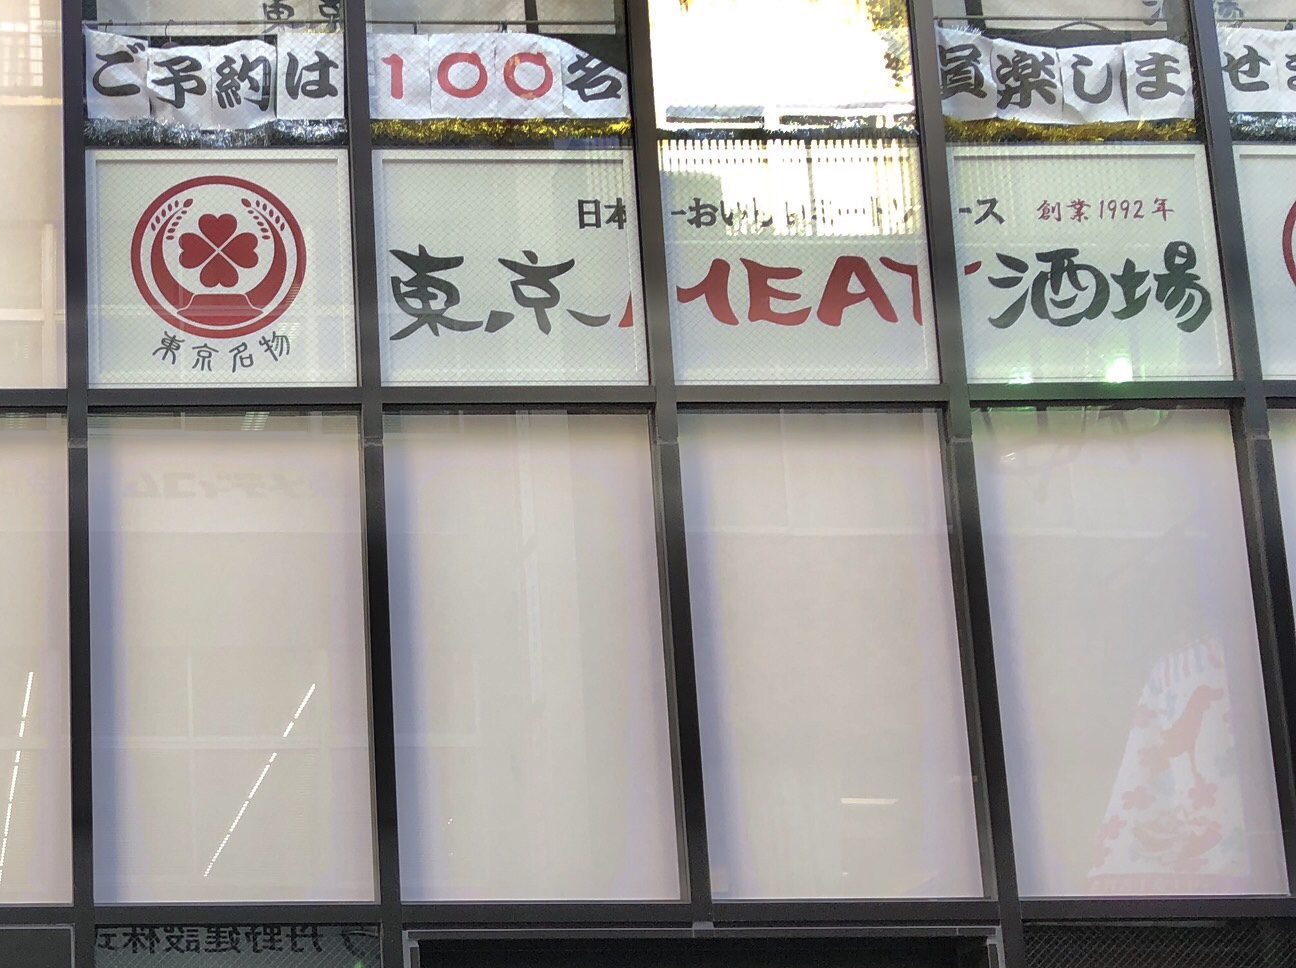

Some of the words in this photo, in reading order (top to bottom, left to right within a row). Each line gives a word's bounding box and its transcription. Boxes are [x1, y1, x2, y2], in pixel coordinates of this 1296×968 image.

[92, 43, 340, 110] ご予約は
[1037, 197, 1176, 222] 創業1992年
[152, 330, 292, 374] 東京名物
